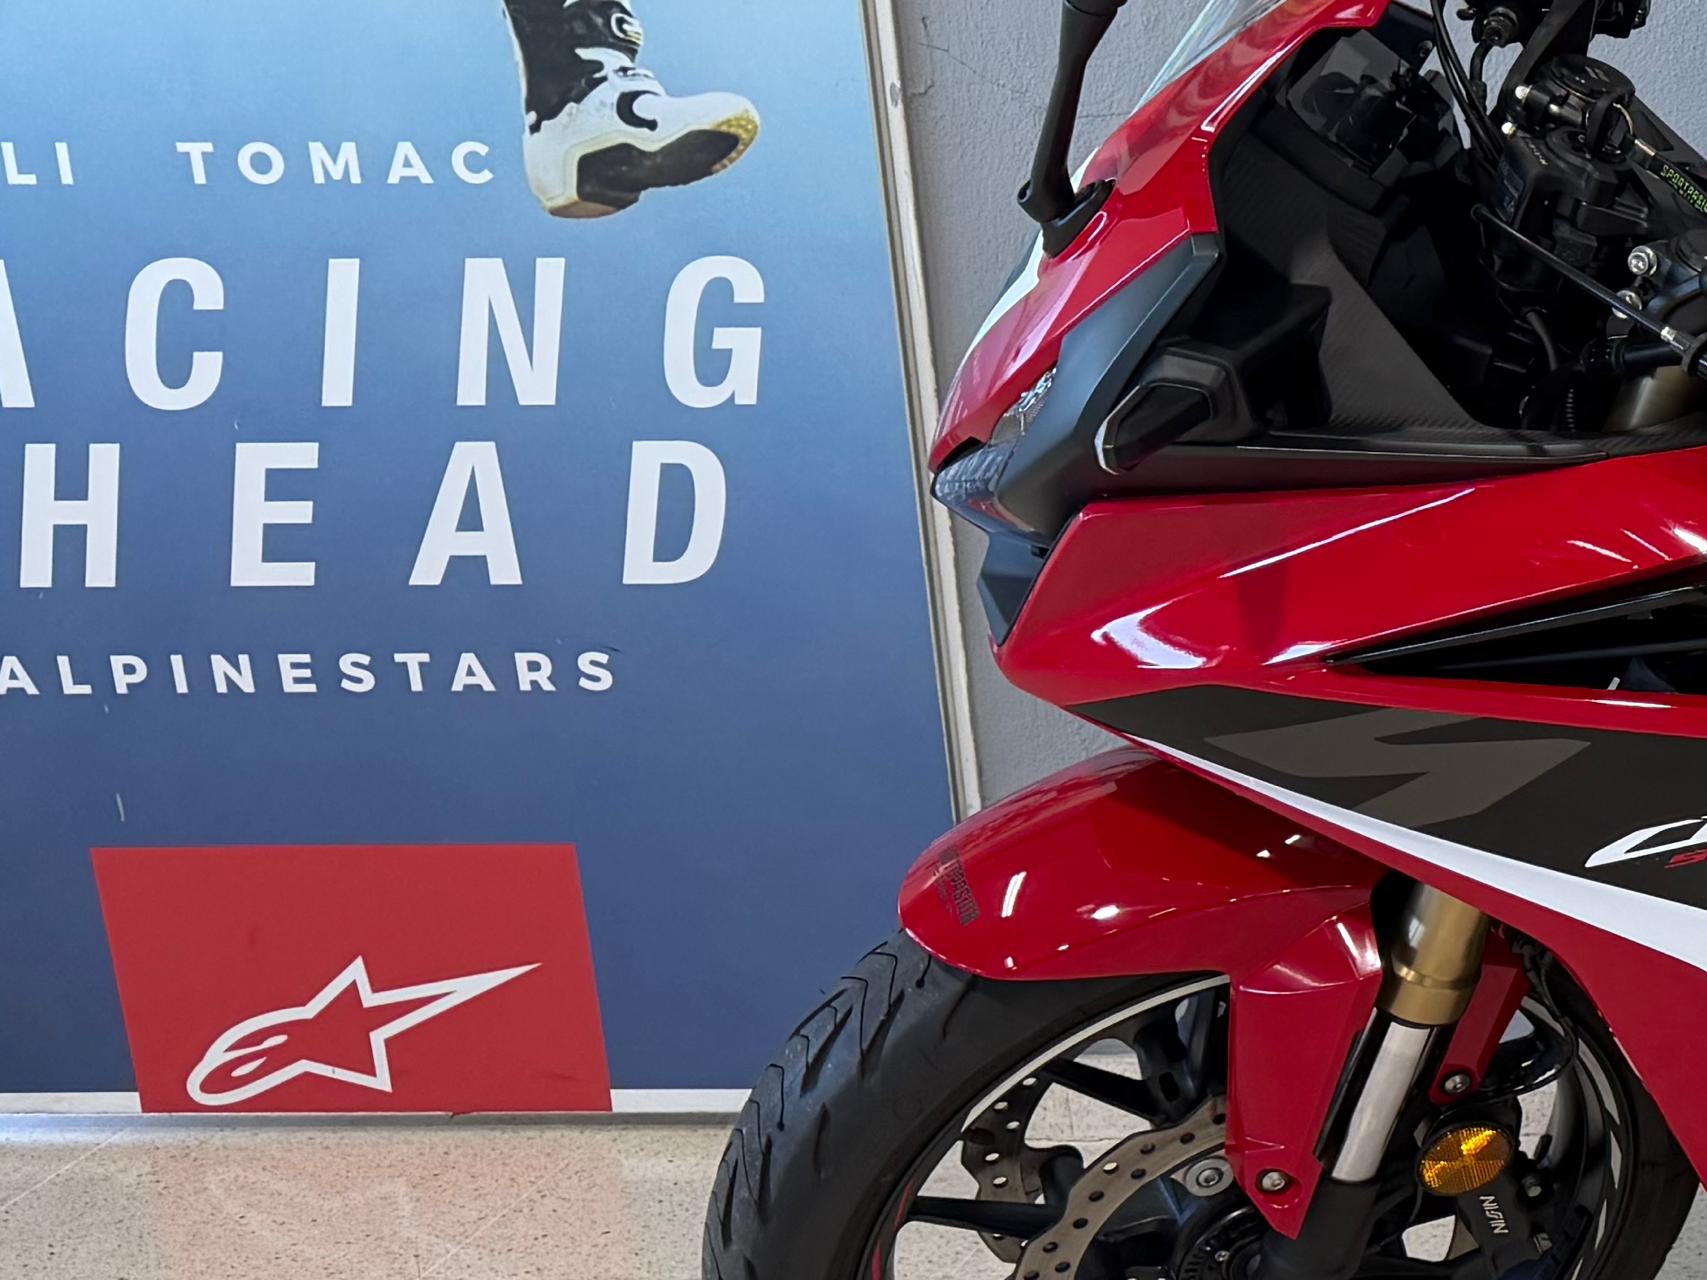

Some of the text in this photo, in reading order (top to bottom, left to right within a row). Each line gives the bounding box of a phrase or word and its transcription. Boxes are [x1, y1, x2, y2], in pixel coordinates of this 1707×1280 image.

[175, 140, 495, 185] TOMAC
[20, 440, 727, 588] HEAD
[0, 651, 614, 695] ALPINESTARS
